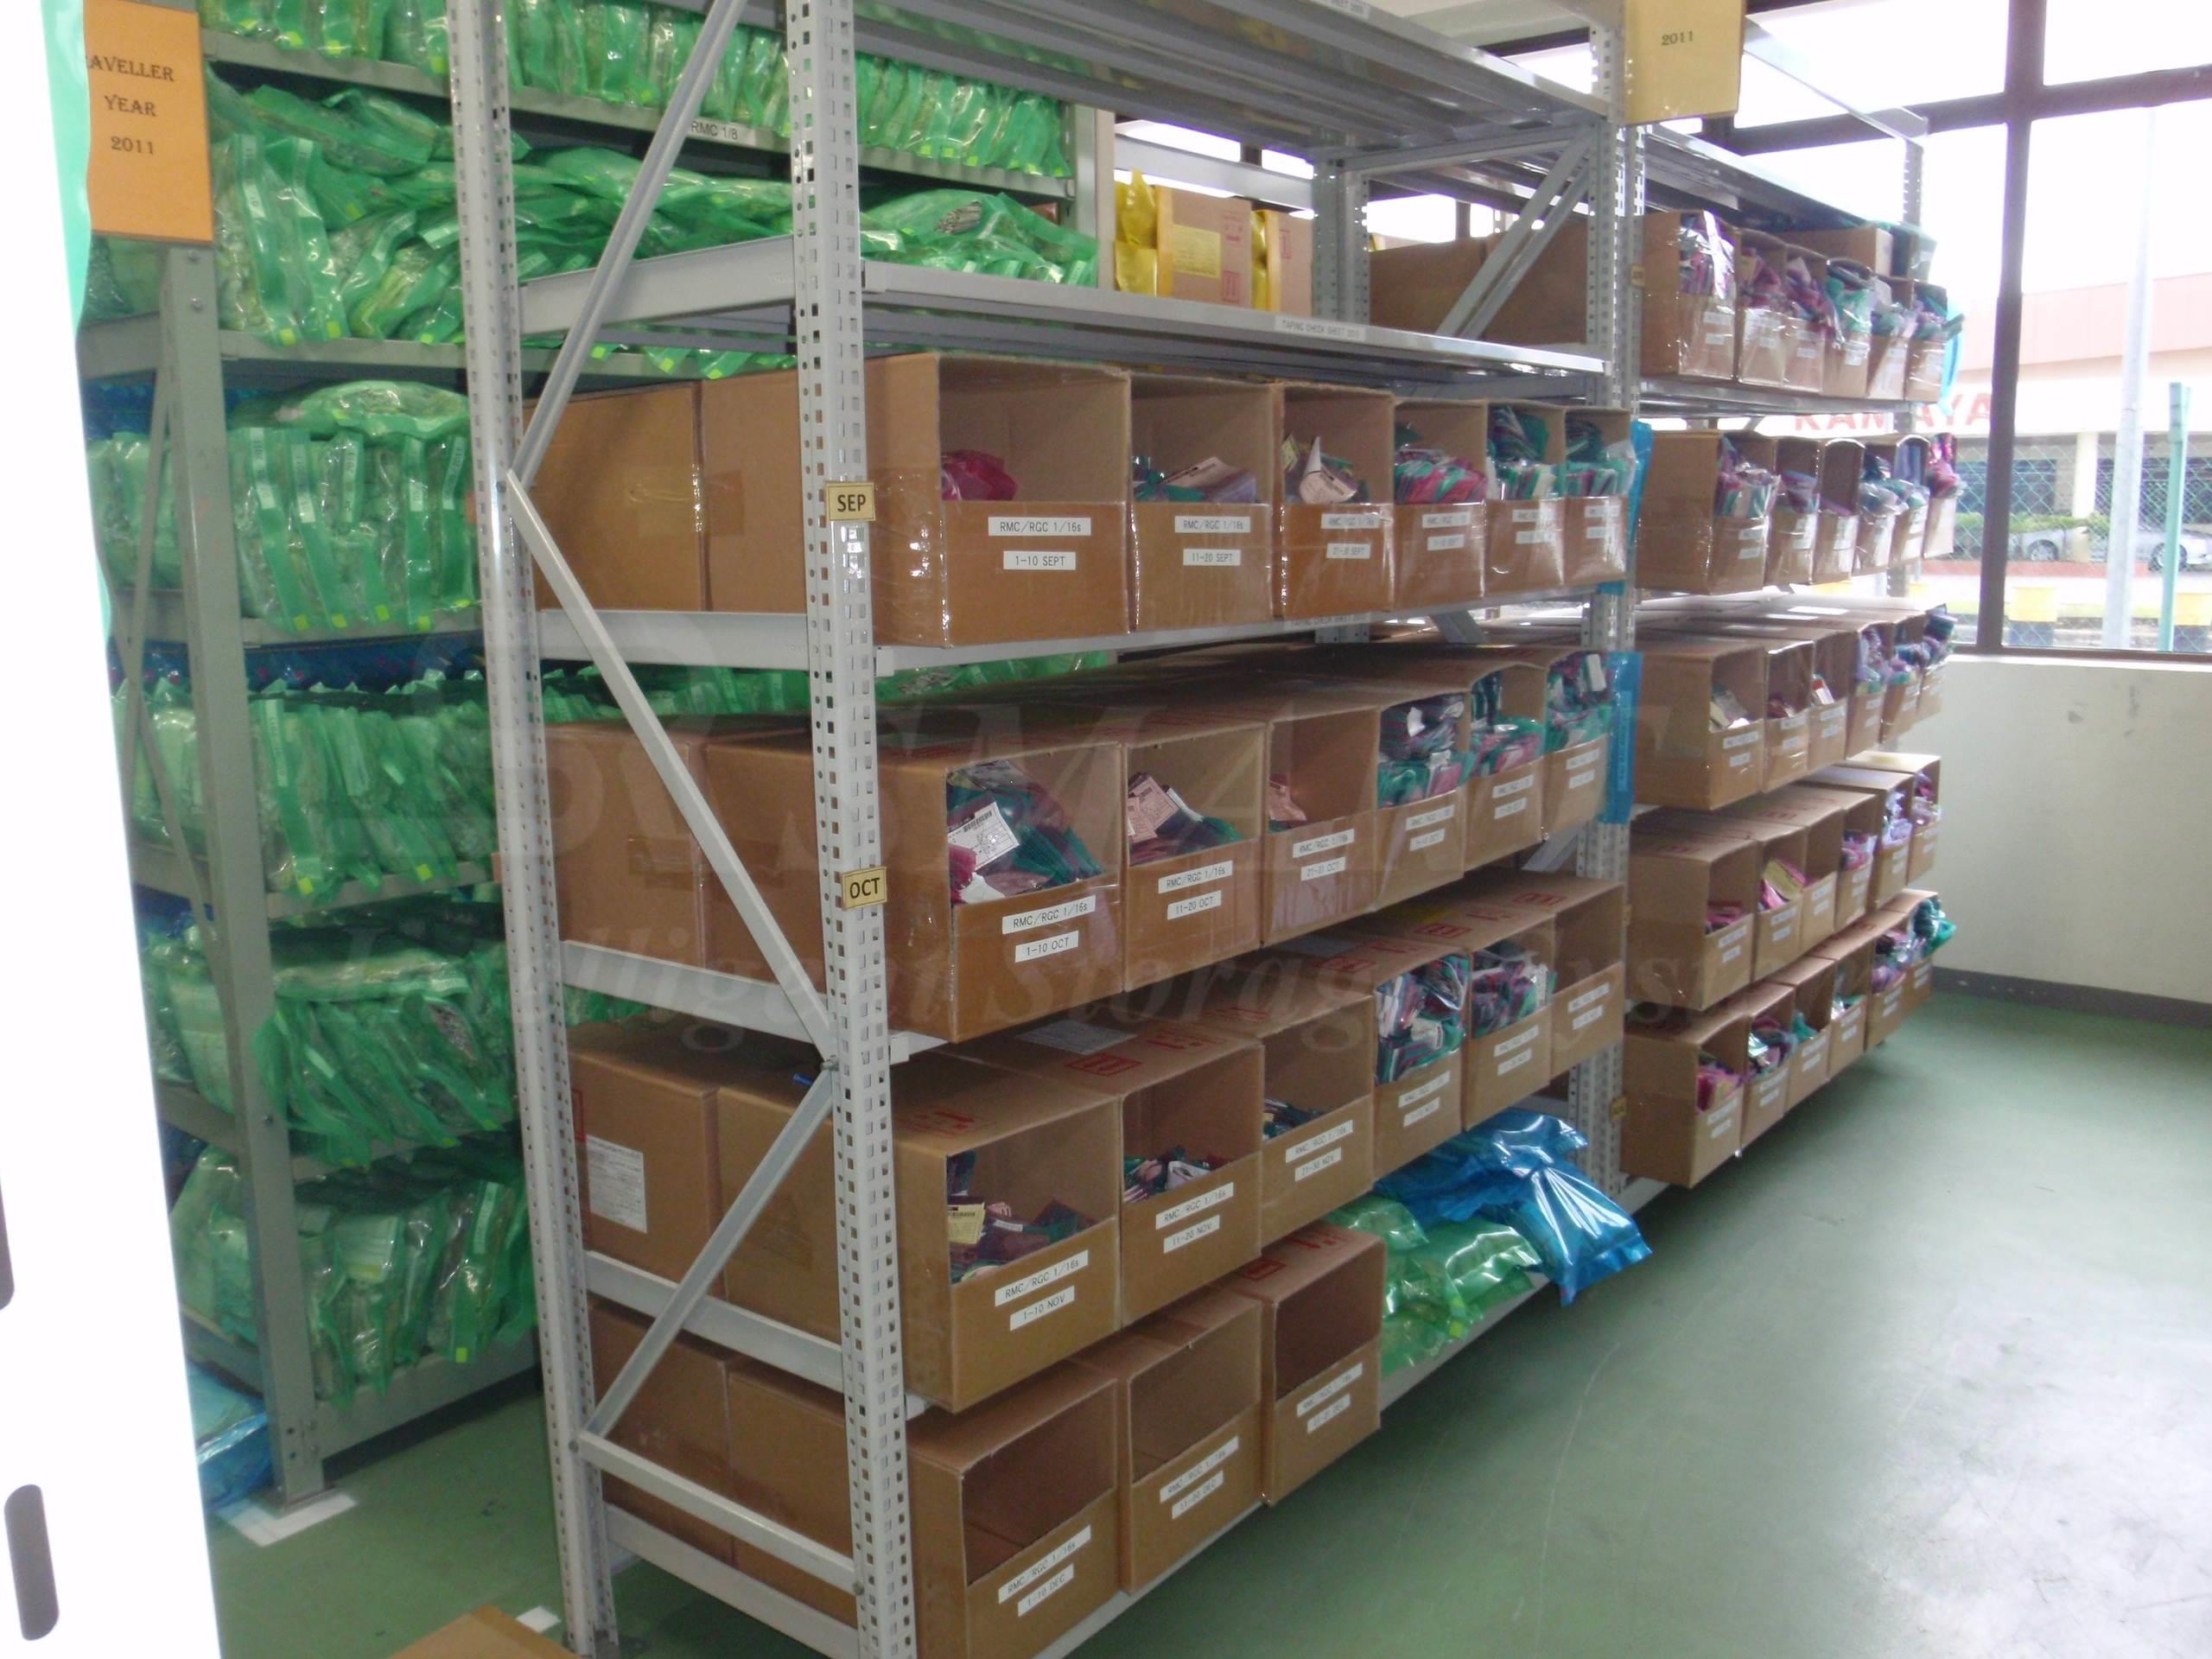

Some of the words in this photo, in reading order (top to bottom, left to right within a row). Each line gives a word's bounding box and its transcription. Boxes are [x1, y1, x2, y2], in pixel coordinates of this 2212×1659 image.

[1661, 30, 1694, 46] 2011
[88, 54, 175, 82] AVELLER
[104, 94, 157, 117] YEAR
[691, 120, 719, 137] RMC
[111, 136, 154, 155] 2011
[836, 493, 867, 512] SEP
[1000, 521, 1049, 532] RMC/RGC
[1053, 522, 1082, 532] 1/16s
[1183, 519, 1220, 530] RMC/RGC
[1015, 556, 1039, 566] 1-10
[1042, 556, 1065, 567] SEPT
[1216, 552, 1234, 563] SEPT
[849, 877, 880, 899] OCT
[1166, 872, 1201, 888] RMC/RGC
[1199, 896, 1215, 908] OCT
[1014, 910, 1059, 928] RMC/RGC
[1064, 903, 1088, 916] 1/16s
[1027, 944, 1048, 956] 1-10
[1052, 938, 1070, 950] OCT
[1196, 1223, 1211, 1234] NOV
[1005, 1272, 1050, 1299] RMC/RGC
[1053, 1260, 1079, 1276] 1/16s
[1023, 1304, 1045, 1320] 1-10
[1047, 1294, 1065, 1308] NOV
[1007, 1559, 1049, 1594] RMC/RGC
[1027, 1587, 1047, 1606] 1-10
[1049, 1573, 1066, 1591] DEC
